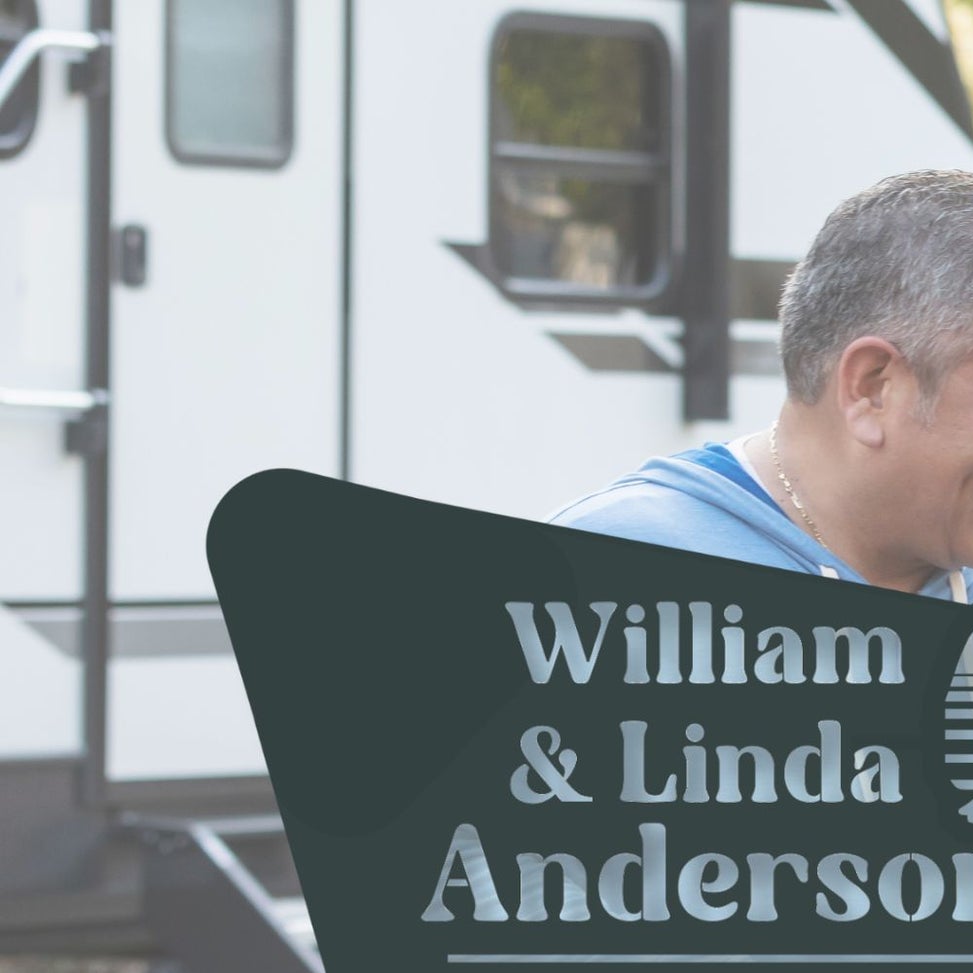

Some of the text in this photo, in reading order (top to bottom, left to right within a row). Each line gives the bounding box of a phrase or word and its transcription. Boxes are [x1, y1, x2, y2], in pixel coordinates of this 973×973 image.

[505, 601, 905, 684] William
[510, 720, 903, 804] & Linda
